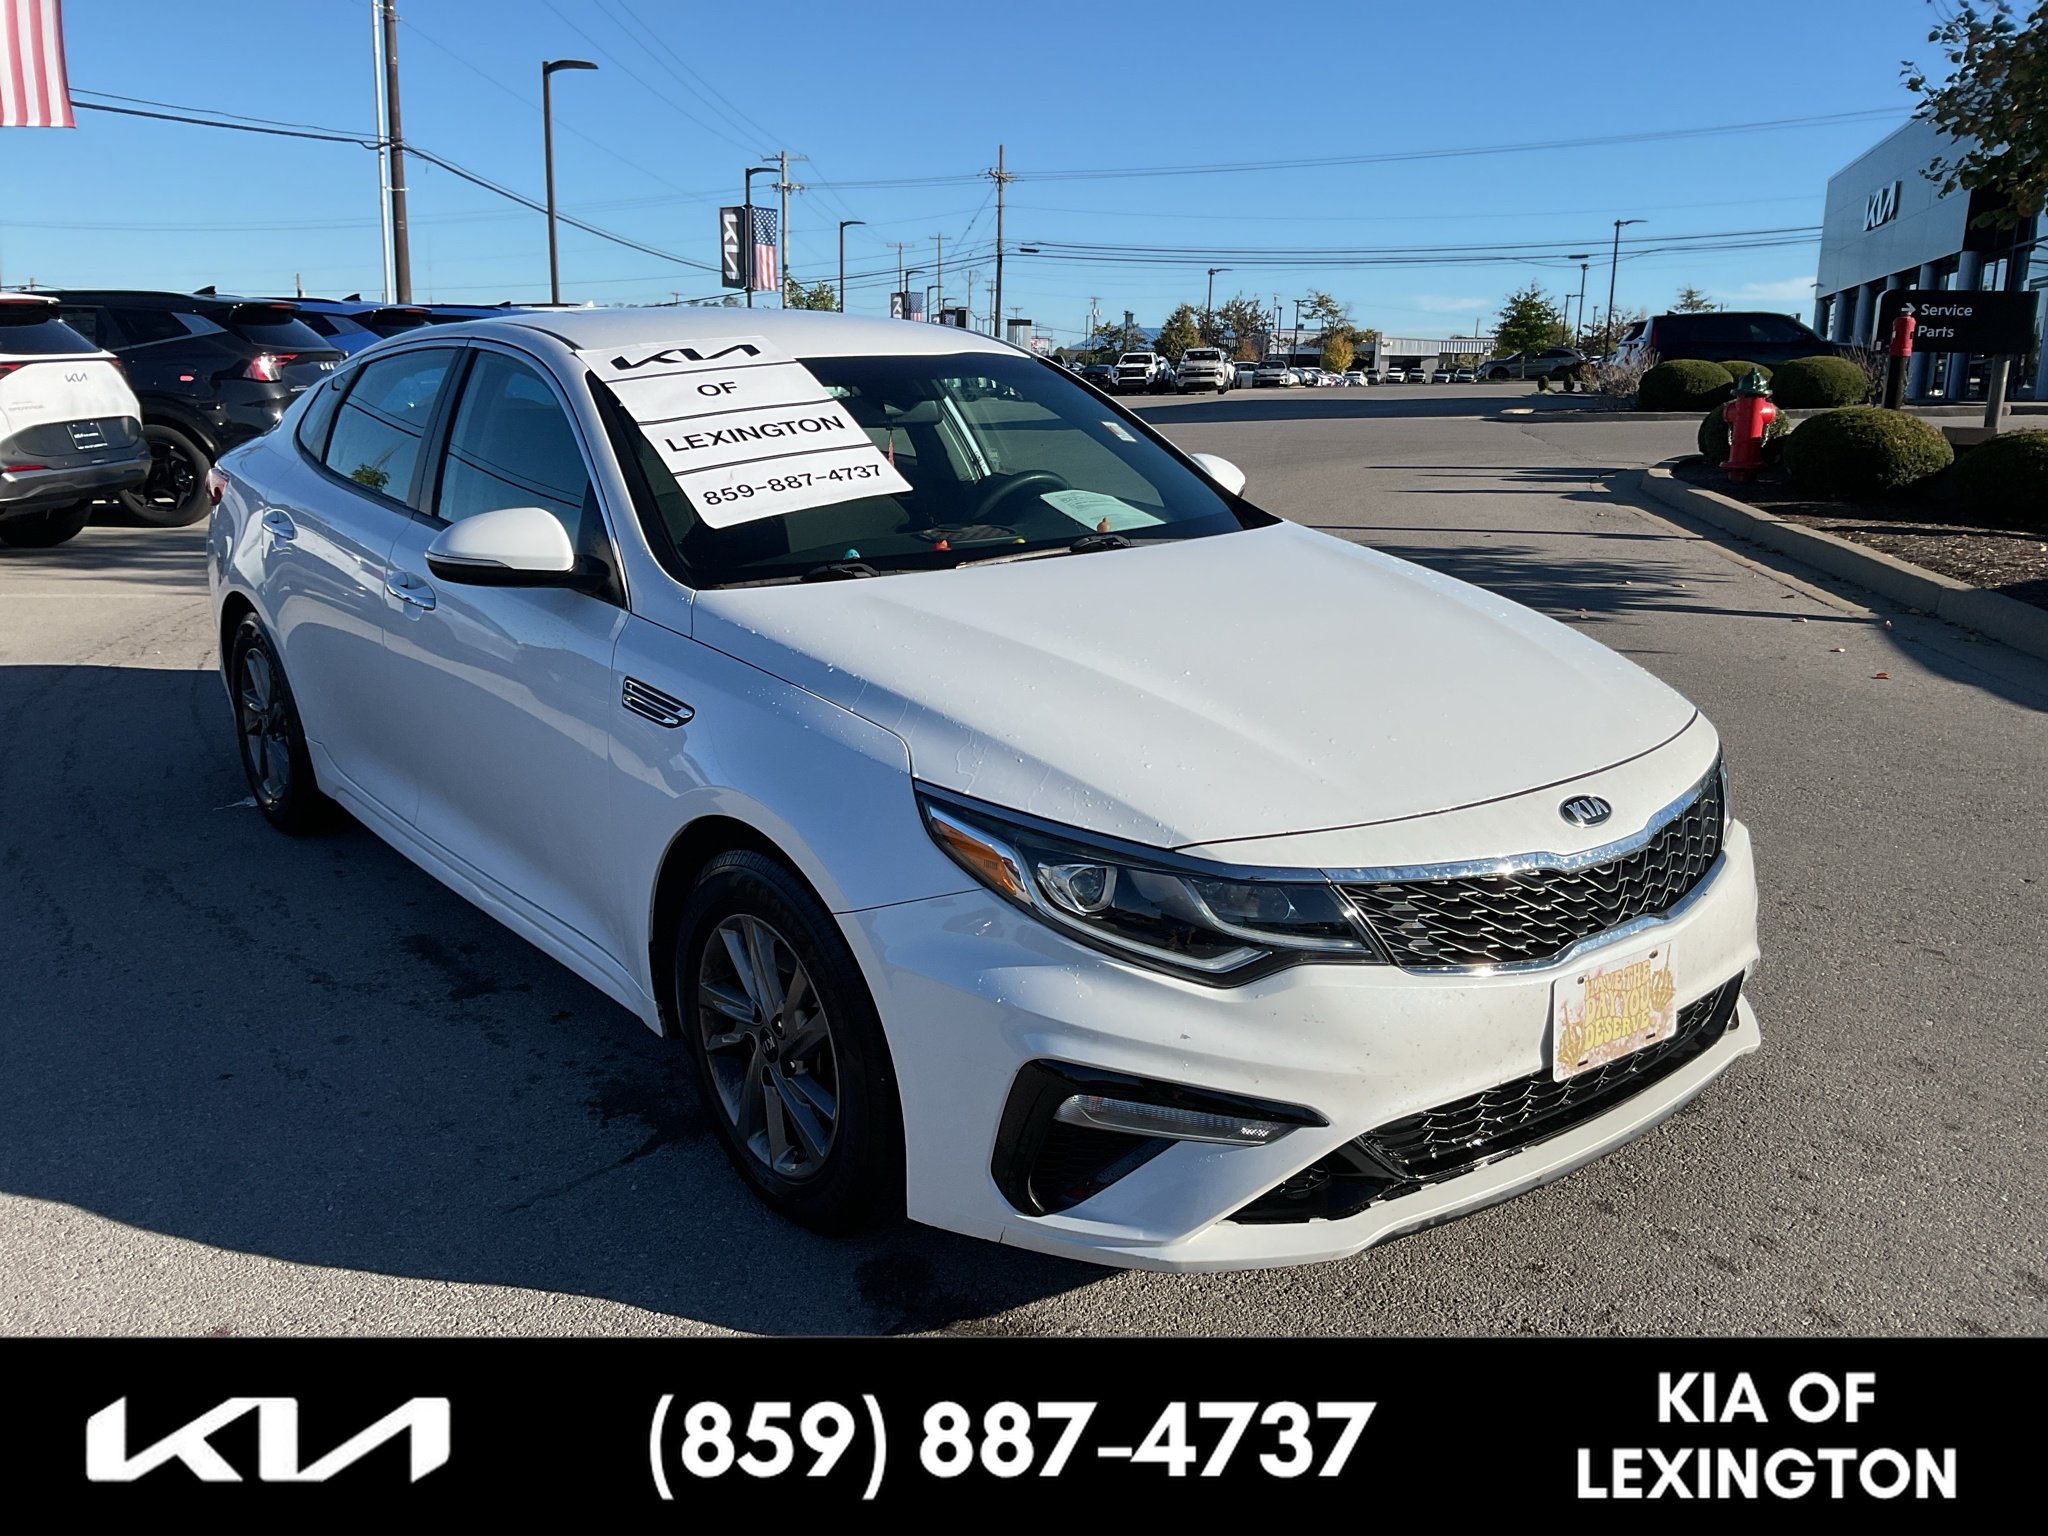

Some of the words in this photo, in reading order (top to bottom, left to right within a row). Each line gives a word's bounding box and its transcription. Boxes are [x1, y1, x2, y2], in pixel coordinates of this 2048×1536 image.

[1863, 181, 1899, 231] KIA
[723, 214, 740, 280] KIA
[1920, 303, 1973, 317] Service
[1917, 325, 1955, 338] Parts
[610, 343, 761, 371] KIA
[64, 372, 88, 383] KIA
[697, 381, 738, 397] OF
[664, 415, 846, 452] LEXINGTON
[702, 464, 882, 506] 859-887-4737
[1565, 797, 1610, 822] KIA
[1584, 969, 1623, 1000] HAVE
[1623, 960, 1651, 990] THE
[1584, 988, 1616, 1028] DAY
[1620, 982, 1650, 1018] YOU
[1584, 1007, 1651, 1052] DESERVE
